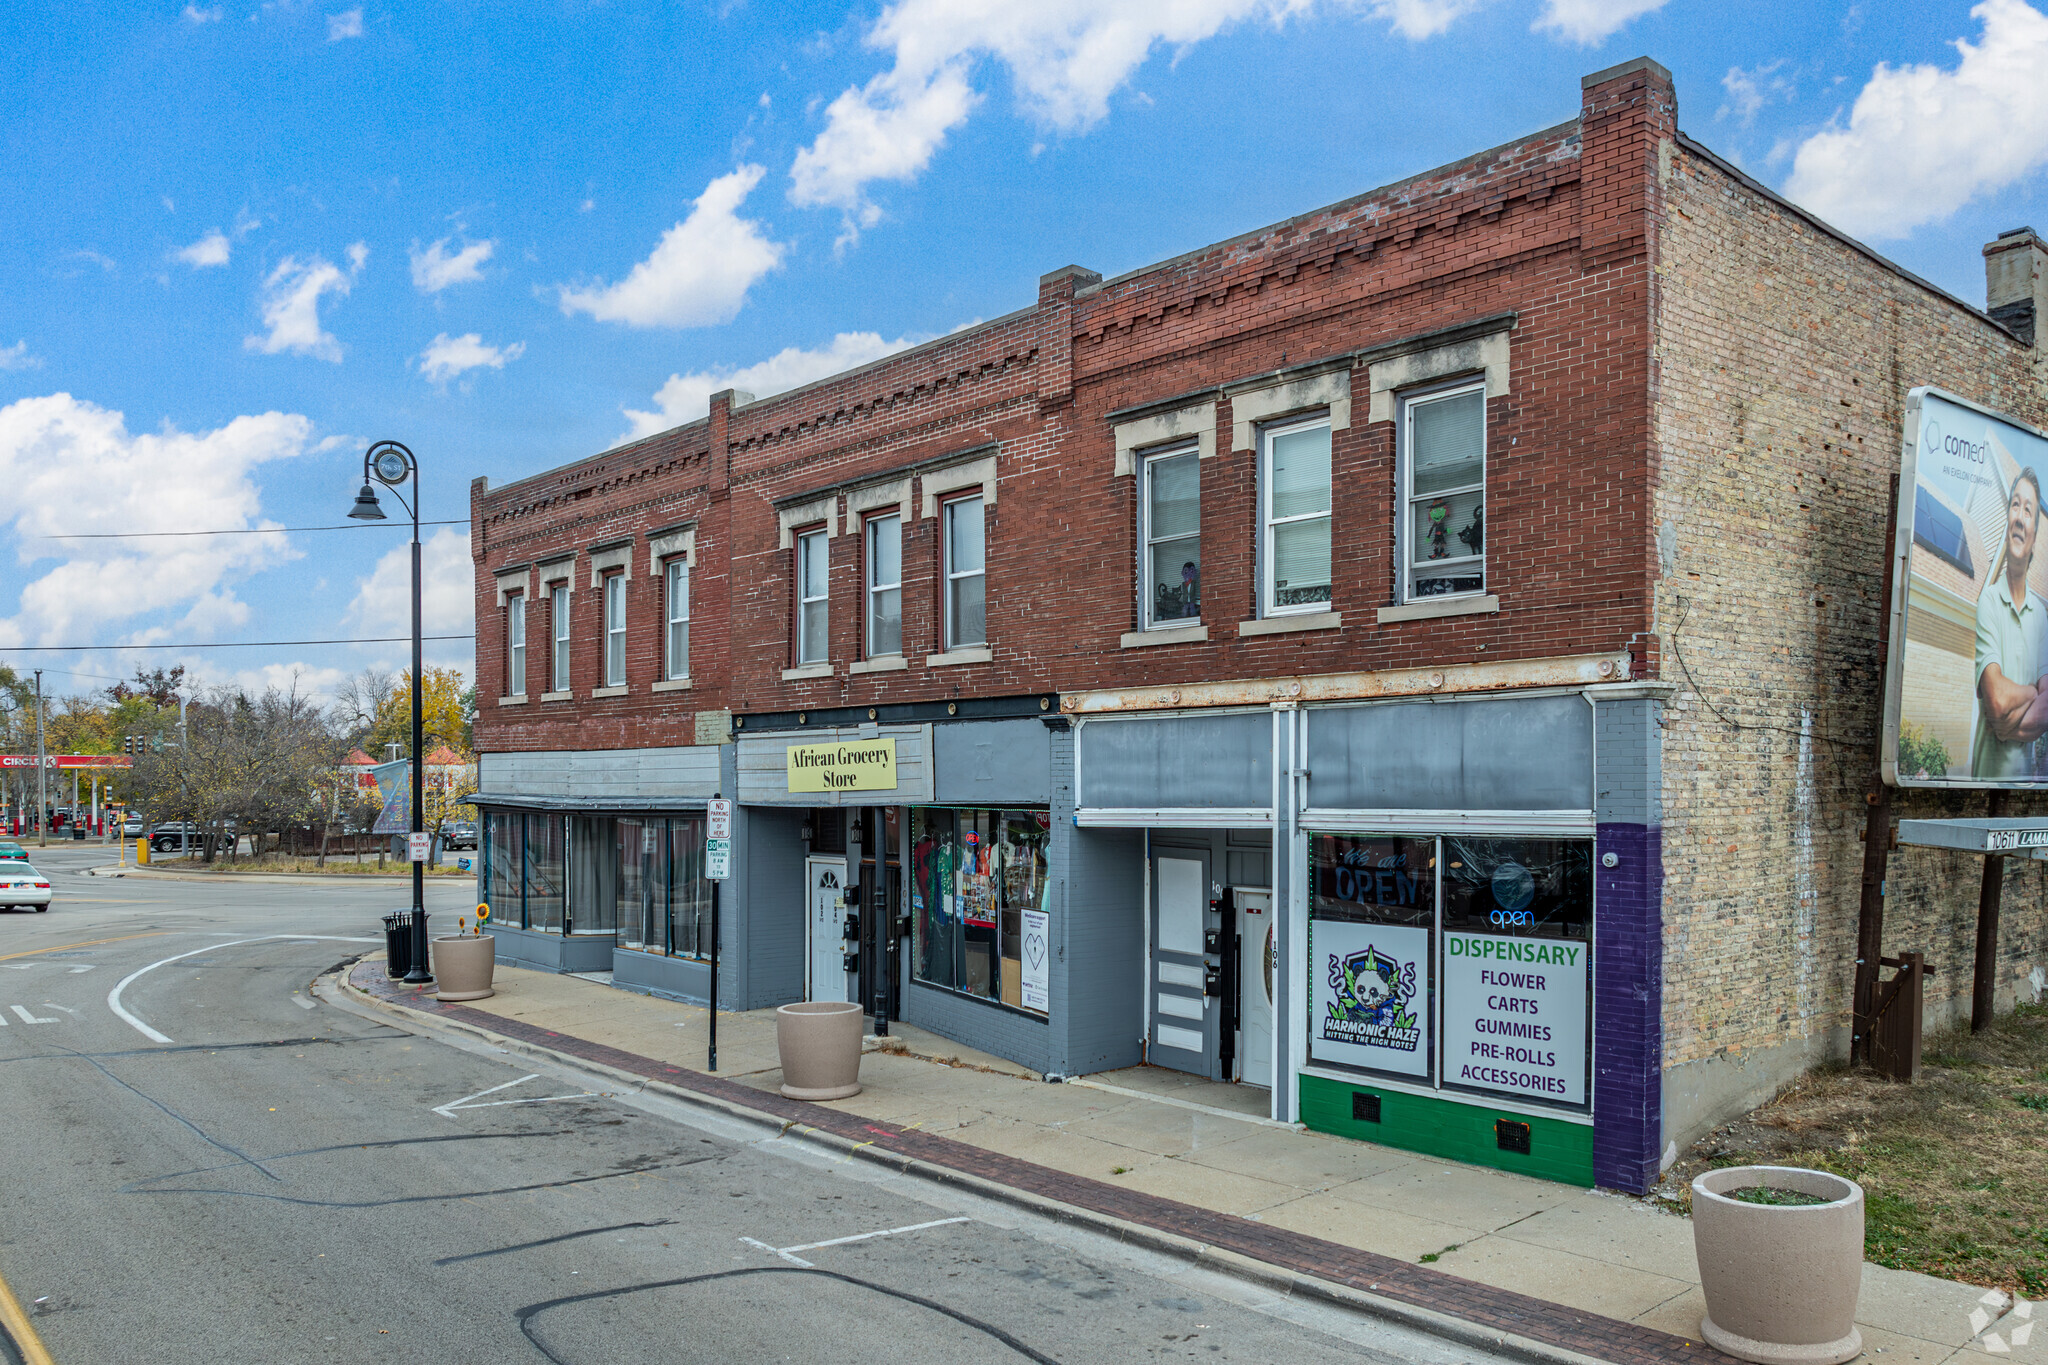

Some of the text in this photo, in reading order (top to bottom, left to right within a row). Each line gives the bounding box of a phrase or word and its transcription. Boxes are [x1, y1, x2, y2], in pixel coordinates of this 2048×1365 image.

[1944, 435, 1986, 464] comed
[1943, 466, 1992, 488] AN EXELON COMPANY
[792, 747, 890, 768] African Grocery
[824, 770, 856, 788] Store
[1992, 832, 2048, 848] 10611 LAMA
[1378, 854, 1406, 868] are
[1336, 866, 1418, 906] OPEN
[1490, 910, 1534, 929] open
[1450, 938, 1580, 966] DISPENSARY
[1482, 970, 1546, 990] FLOWER
[1488, 995, 1538, 1014] CARTS
[1325, 1018, 1419, 1042] HARMONIC HAZE
[1475, 1018, 1551, 1041] GUMMIES
[1326, 1031, 1414, 1050] HITTING THE HIGH NOTES
[1471, 1042, 1555, 1067] PRE-ROLLS
[1461, 1064, 1566, 1094] ACCESSORIES
